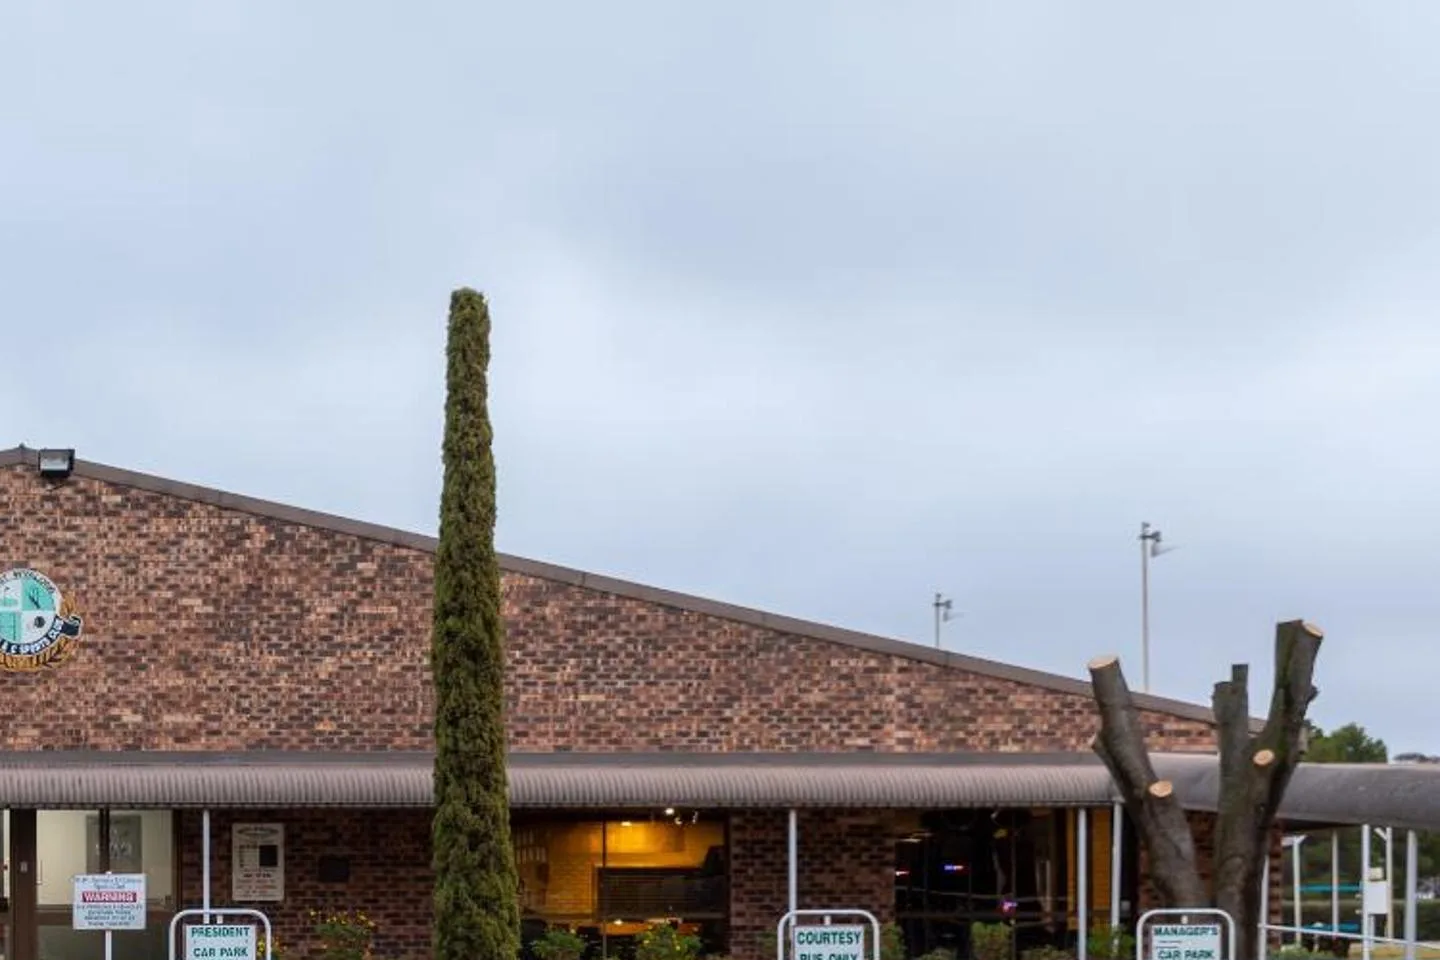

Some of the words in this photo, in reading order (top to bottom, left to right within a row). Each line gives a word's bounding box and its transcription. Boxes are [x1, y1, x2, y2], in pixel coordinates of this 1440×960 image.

[84, 892, 134, 900] WARNING
[191, 927, 250, 937] PRESIDENT
[797, 931, 861, 945] COURTESY
[193, 947, 216, 957] CAR
[220, 946, 248, 957] PARK
[1157, 949, 1181, 959] CAR
[1184, 949, 1215, 959] PARK
